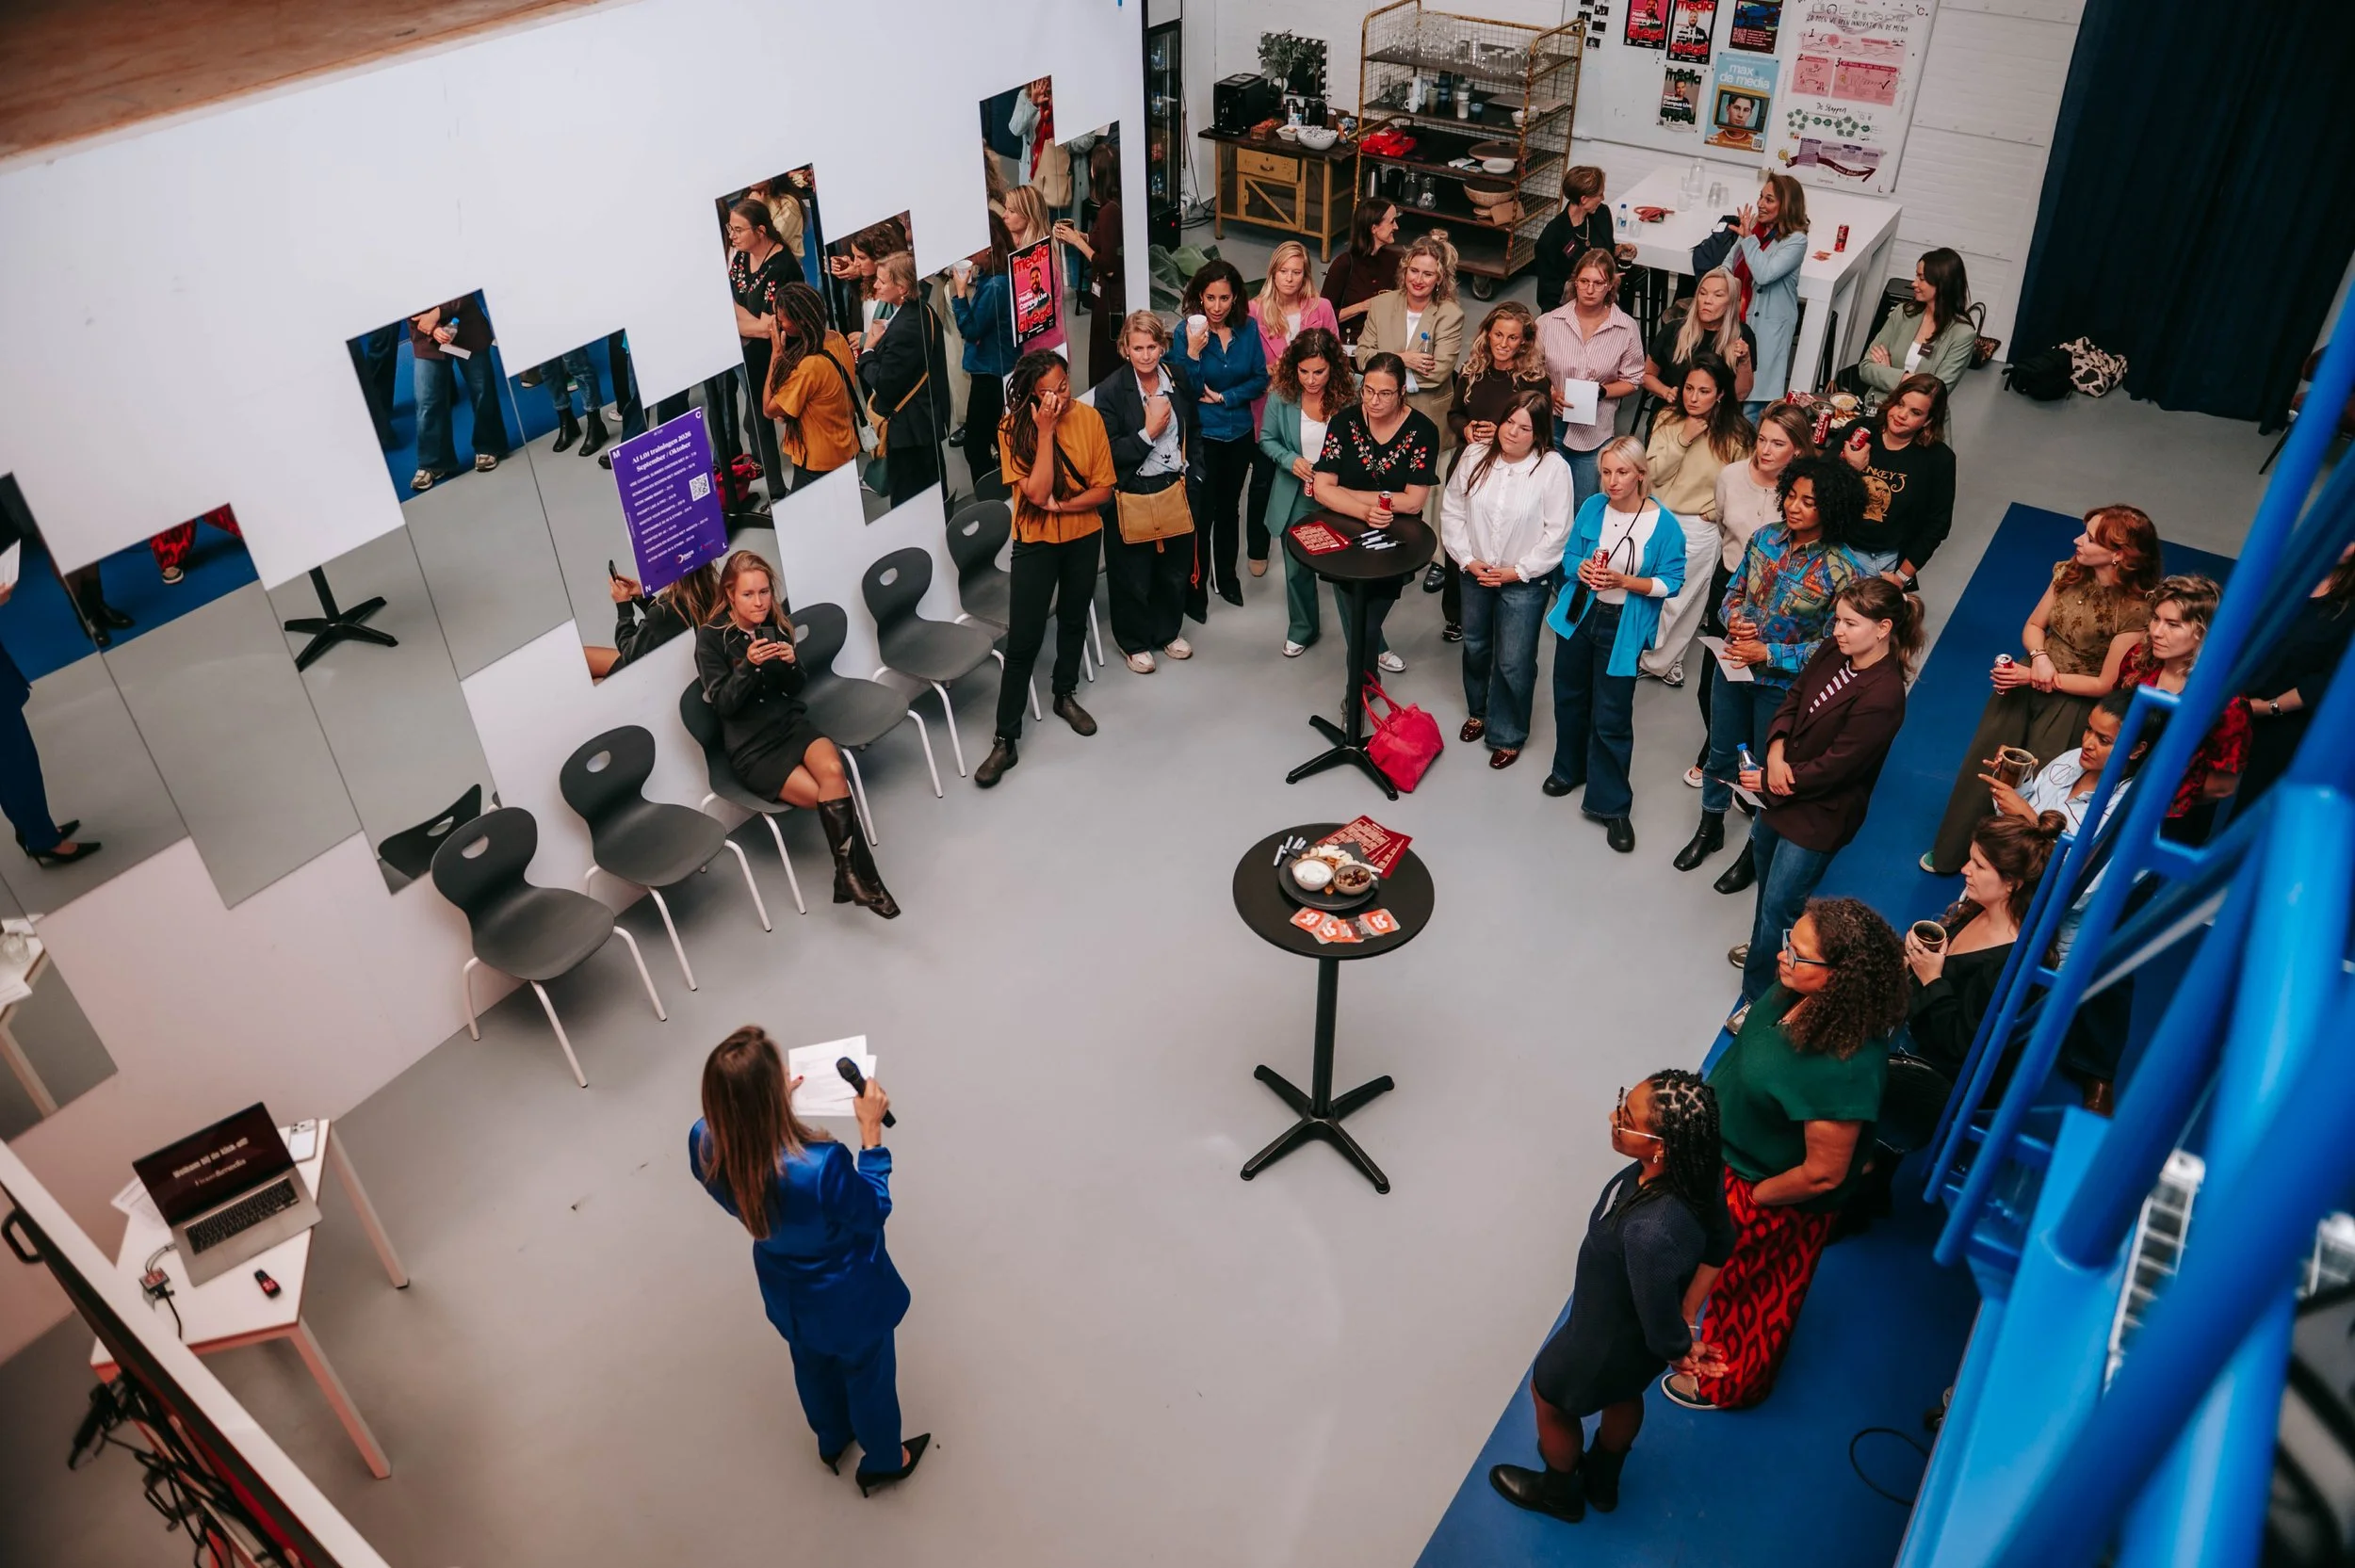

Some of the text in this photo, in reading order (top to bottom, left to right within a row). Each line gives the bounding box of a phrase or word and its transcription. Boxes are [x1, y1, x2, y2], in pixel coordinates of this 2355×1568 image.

[1628, 24, 1665, 41] ahead
[1671, 41, 1709, 56] ahead
[1730, 64, 1755, 76] max
[1719, 72, 1770, 89] de media
[1013, 244, 1049, 275] media
[1018, 300, 1053, 333] ahead
[695, 411, 702, 419] C
[612, 450, 621, 459] M
[650, 437, 677, 456] trainingen
[637, 453, 666, 473] September
[669, 441, 691, 456] Oktober
[645, 584, 652, 593] N
